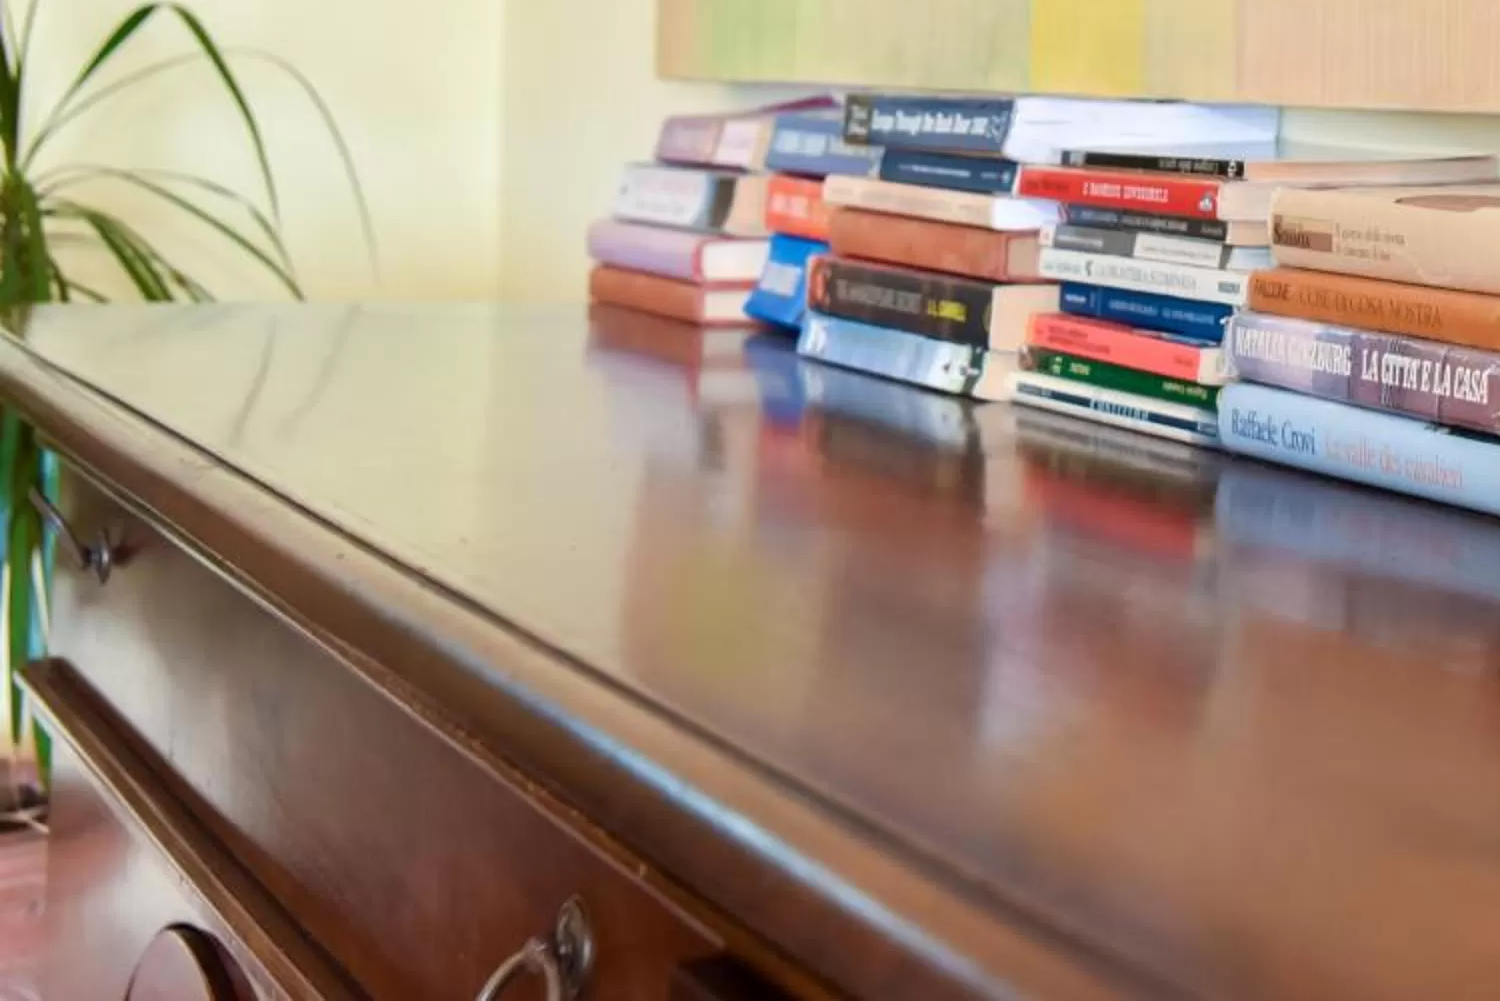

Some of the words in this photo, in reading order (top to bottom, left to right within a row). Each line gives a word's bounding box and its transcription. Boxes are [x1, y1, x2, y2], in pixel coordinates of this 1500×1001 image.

[1298, 285, 1334, 310] COSE
[1335, 290, 1348, 312] DI
[1348, 292, 1386, 319] COSA
[1387, 296, 1443, 328] NOSTRA
[1235, 326, 1286, 362] NATALIA
[1288, 334, 1352, 376] GINZBURG
[1361, 350, 1380, 380] LA
[1420, 363, 1432, 394] E
[1433, 365, 1451, 396] LA
[1453, 368, 1489, 404] CASA
[1231, 407, 1279, 447] Raffaele
[1281, 420, 1316, 456] Crovi
